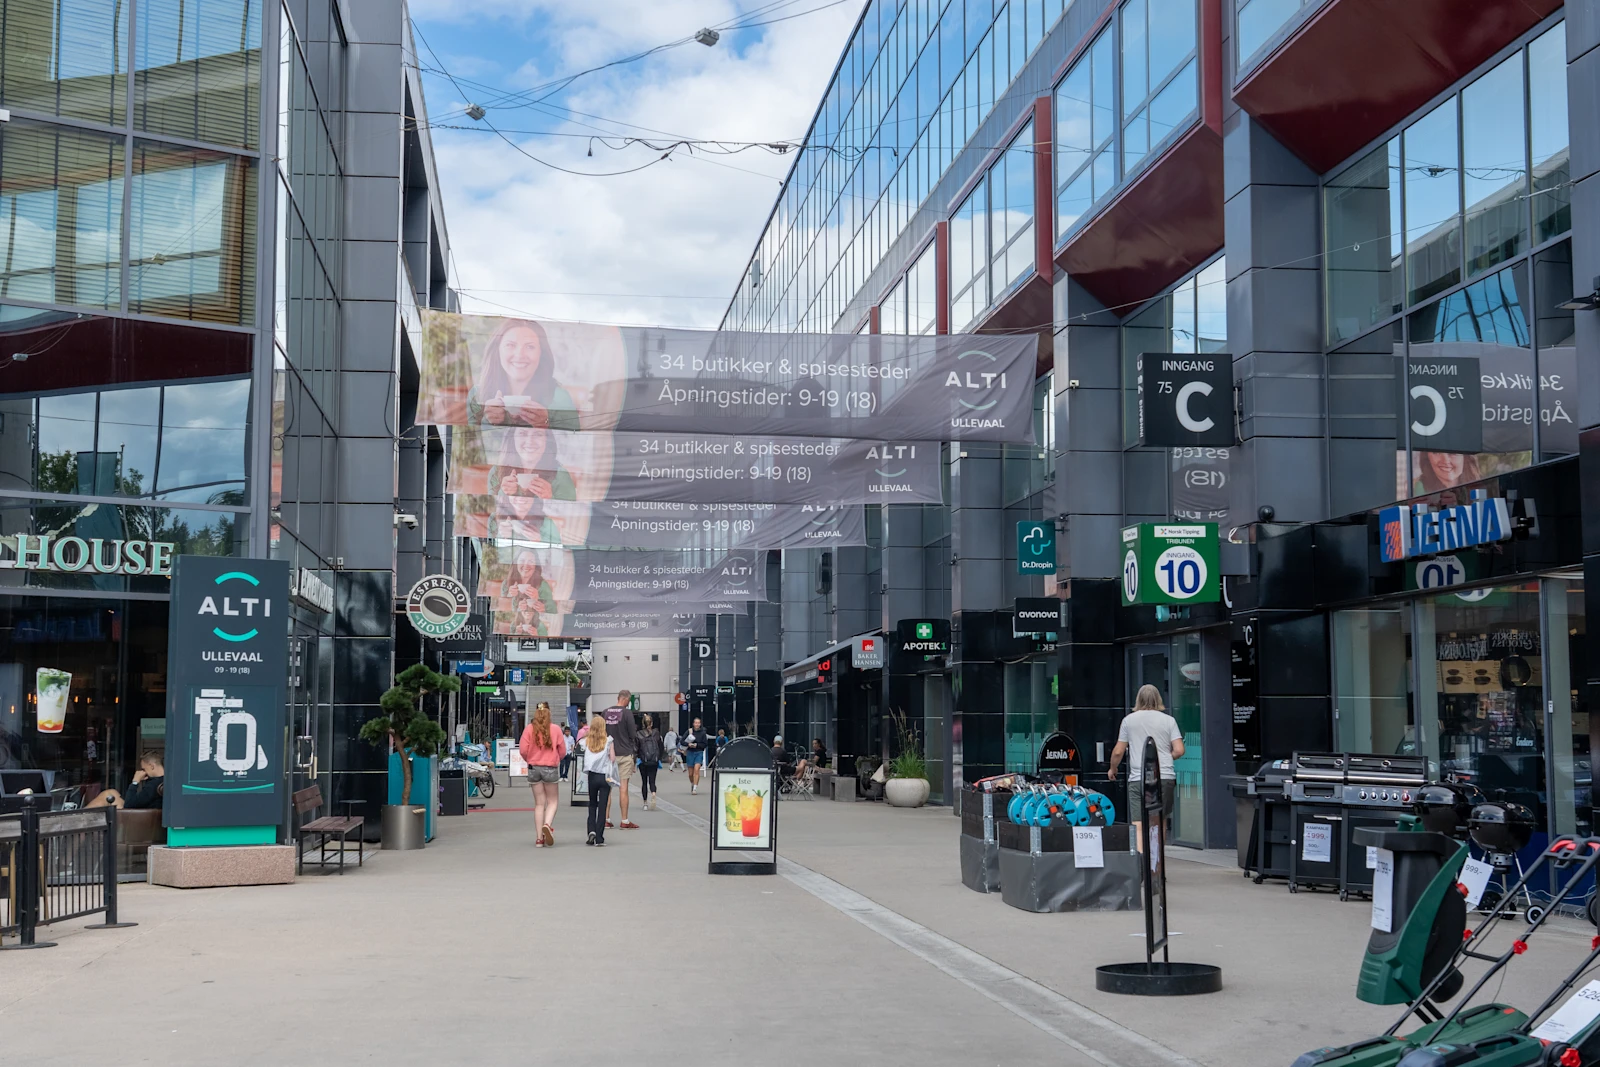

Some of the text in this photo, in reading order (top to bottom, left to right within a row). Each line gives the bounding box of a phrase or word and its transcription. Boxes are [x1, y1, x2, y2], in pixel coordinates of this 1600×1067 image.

[660, 355, 911, 381] 34 butikker & spisesteder
[1162, 361, 1214, 372] INNGANG
[945, 371, 1006, 389] ALTI
[1157, 381, 1173, 394] 75
[658, 380, 877, 413] Åpningstider: 9-19 (18)
[1175, 381, 1215, 432] C
[951, 418, 1005, 428] ULLEVAAL
[639, 440, 840, 459] 34 butikker & spisesteder
[866, 445, 916, 460] ALTI
[638, 460, 812, 483] Åpningstider: 9-19 (18)
[868, 484, 913, 493] ULLEVAAL
[611, 515, 755, 534] Åpningstider: 9-19 (18)
[805, 530, 842, 539] ULLEVAAL
[14, 534, 175, 575] HOUSE
[589, 565, 706, 576] 34 butikker & spisesteder
[721, 567, 752, 576] ALTI
[1022, 561, 1053, 570] Dr.Dropin
[588, 577, 689, 590] Åpningstider: 9-19 (18)
[1125, 562, 1136, 596] 10
[1160, 560, 1200, 594] 10
[412, 579, 465, 602] ESPRESSO
[198, 596, 271, 617] ALTI
[417, 618, 459, 634] HOUSE
[459, 624, 482, 633] DRIK
[574, 620, 620, 630] Åpningstider:
[202, 651, 263, 662] ULLEVAAL
[699, 643, 711, 658] D
[214, 666, 224, 674] 09
[229, 666, 237, 674] 19
[238, 666, 251, 675] (18)
[1465, 864, 1483, 875] 999,-
